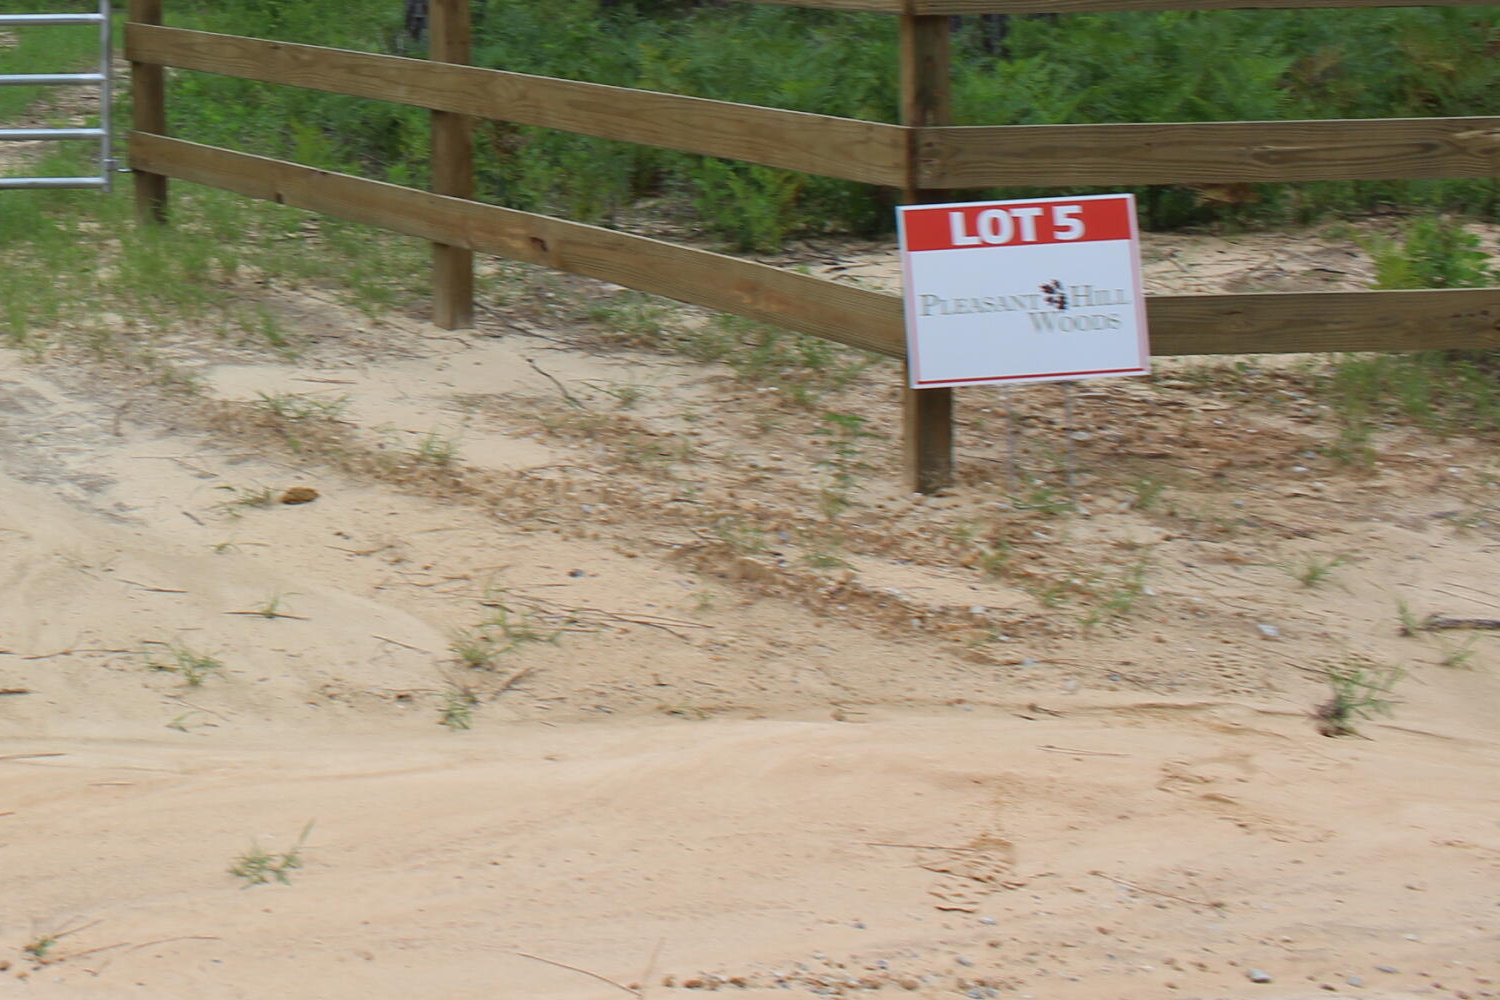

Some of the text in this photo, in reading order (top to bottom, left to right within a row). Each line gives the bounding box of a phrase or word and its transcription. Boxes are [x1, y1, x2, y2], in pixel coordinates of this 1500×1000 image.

[949, 204, 1086, 245] LOT 5
[918, 285, 1131, 316] PLEASANT HILL
[1028, 311, 1122, 333] WOODS
